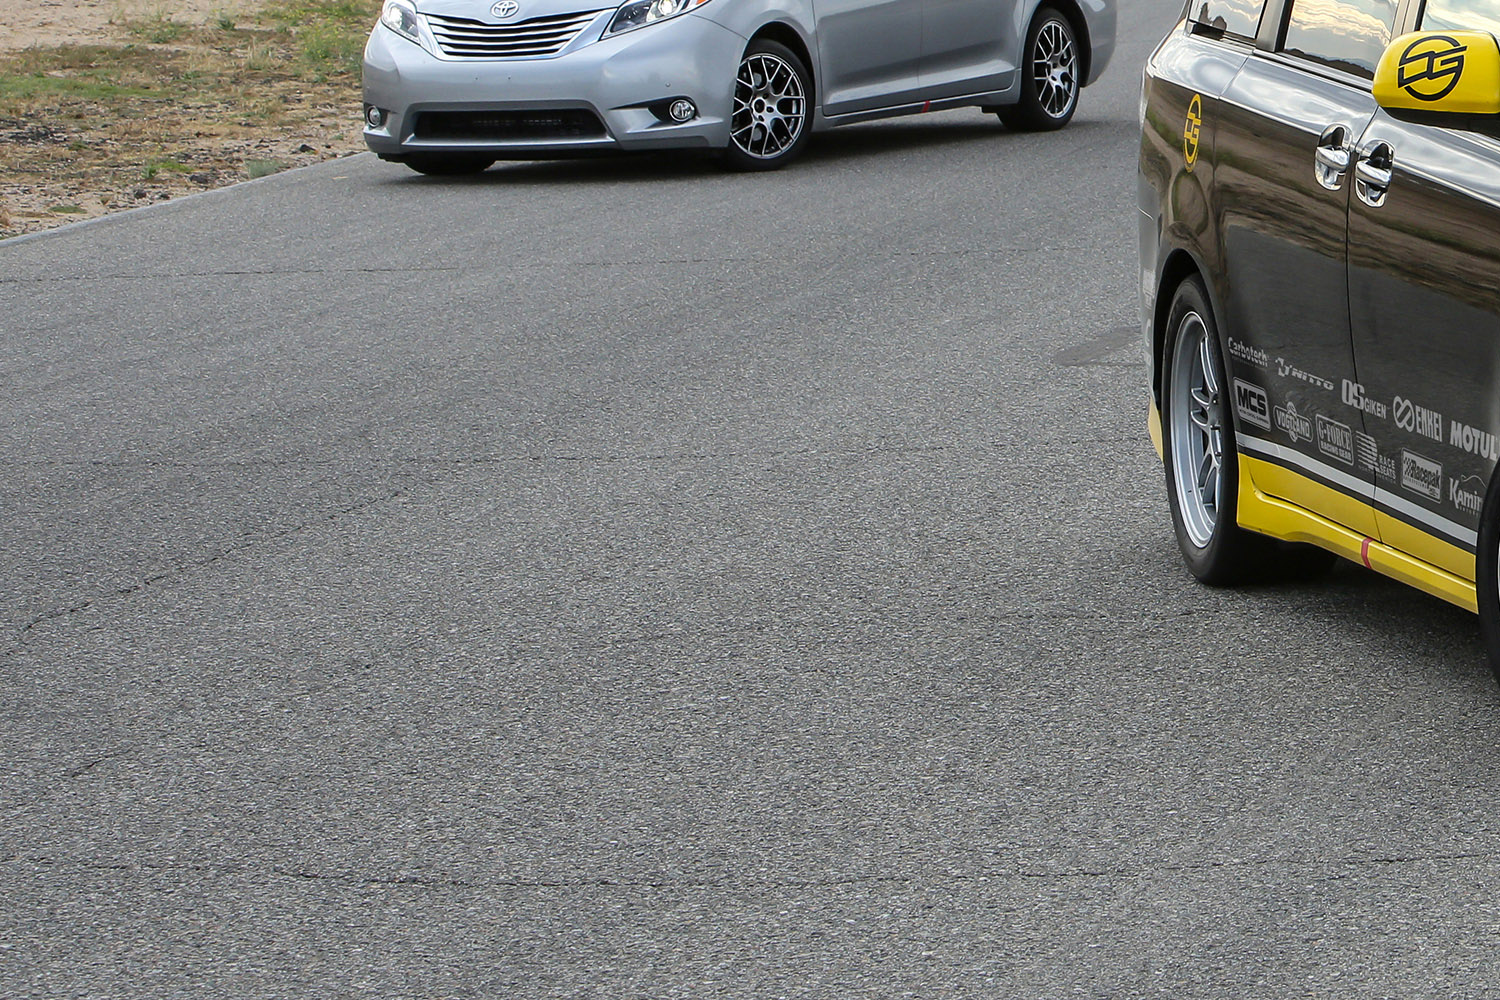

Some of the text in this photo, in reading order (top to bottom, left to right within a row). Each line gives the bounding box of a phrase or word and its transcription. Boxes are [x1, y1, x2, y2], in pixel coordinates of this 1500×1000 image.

[1291, 367, 1334, 390] NITTO
[1237, 385, 1267, 417] MCS
[1341, 378, 1387, 420] OS GIKEN
[1415, 405, 1443, 442] ENKEI
[1450, 420, 1498, 461] MOTUL
[1379, 454, 1396, 469] RACE
[1379, 465, 1396, 480] SEATS
